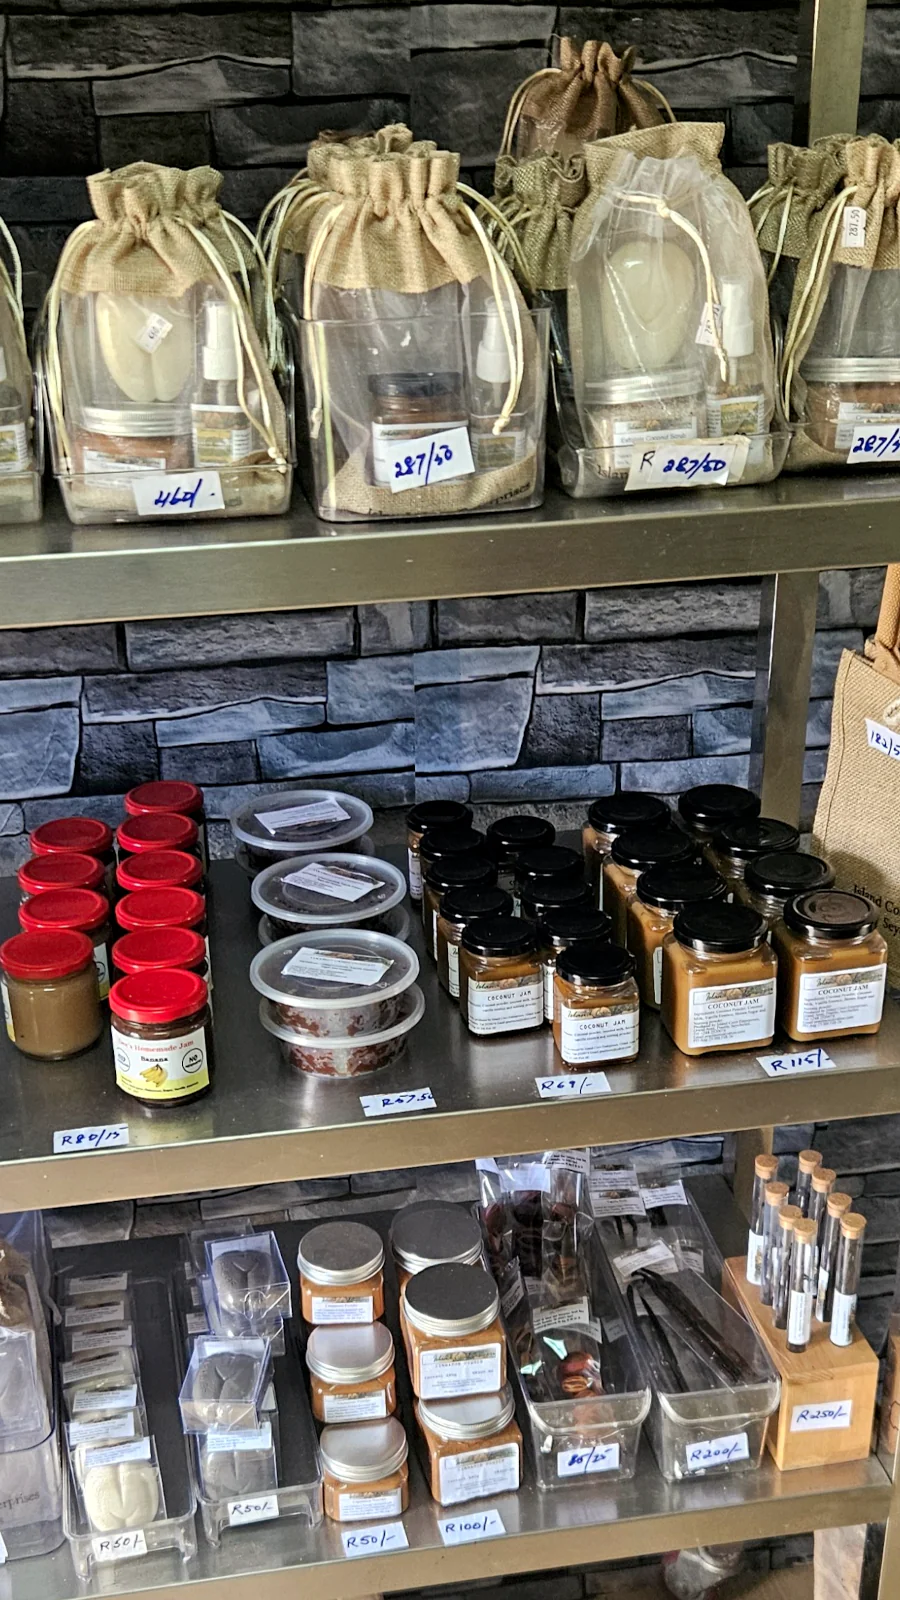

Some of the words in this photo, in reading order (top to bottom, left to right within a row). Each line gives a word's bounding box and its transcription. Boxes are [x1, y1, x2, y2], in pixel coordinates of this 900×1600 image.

[848, 208, 861, 239] 287.50
[394, 441, 454, 486] 287/50
[639, 450, 656, 471] R
[662, 452, 727, 480] 287/50
[854, 884, 882, 909] Island
[818, 986, 853, 996] COCONUT
[853, 983, 869, 992] JAM
[487, 993, 516, 1001] COCONUT
[707, 1000, 743, 1010] COCONUT
[744, 997, 760, 1006] JAM
[579, 1022, 609, 1030] COCONUT
[612, 1018, 626, 1026] JAM
[178, 1039, 194, 1049] Jam
